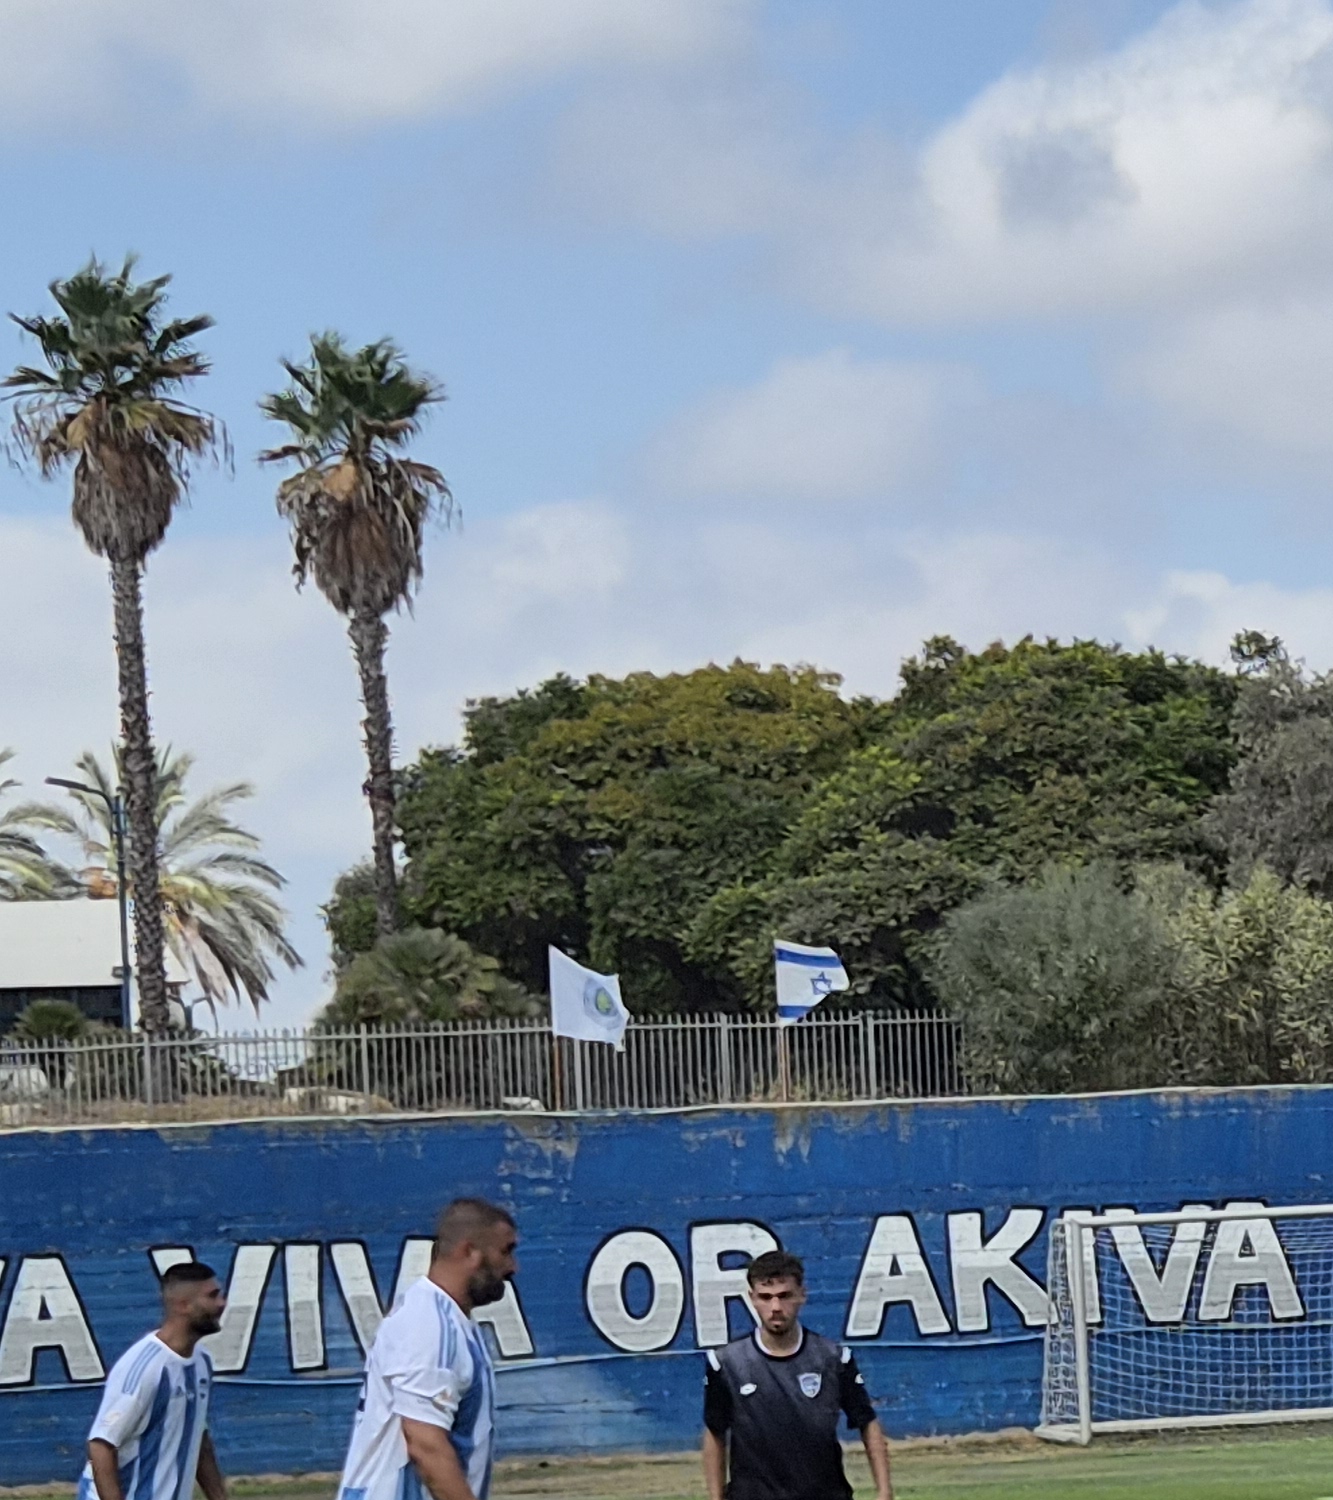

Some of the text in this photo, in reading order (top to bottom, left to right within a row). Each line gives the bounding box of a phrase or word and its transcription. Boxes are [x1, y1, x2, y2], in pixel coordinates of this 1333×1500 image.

[0, 1252, 107, 1388] A
[583, 1217, 784, 1353] OR
[844, 1197, 1307, 1340] AKIVA
